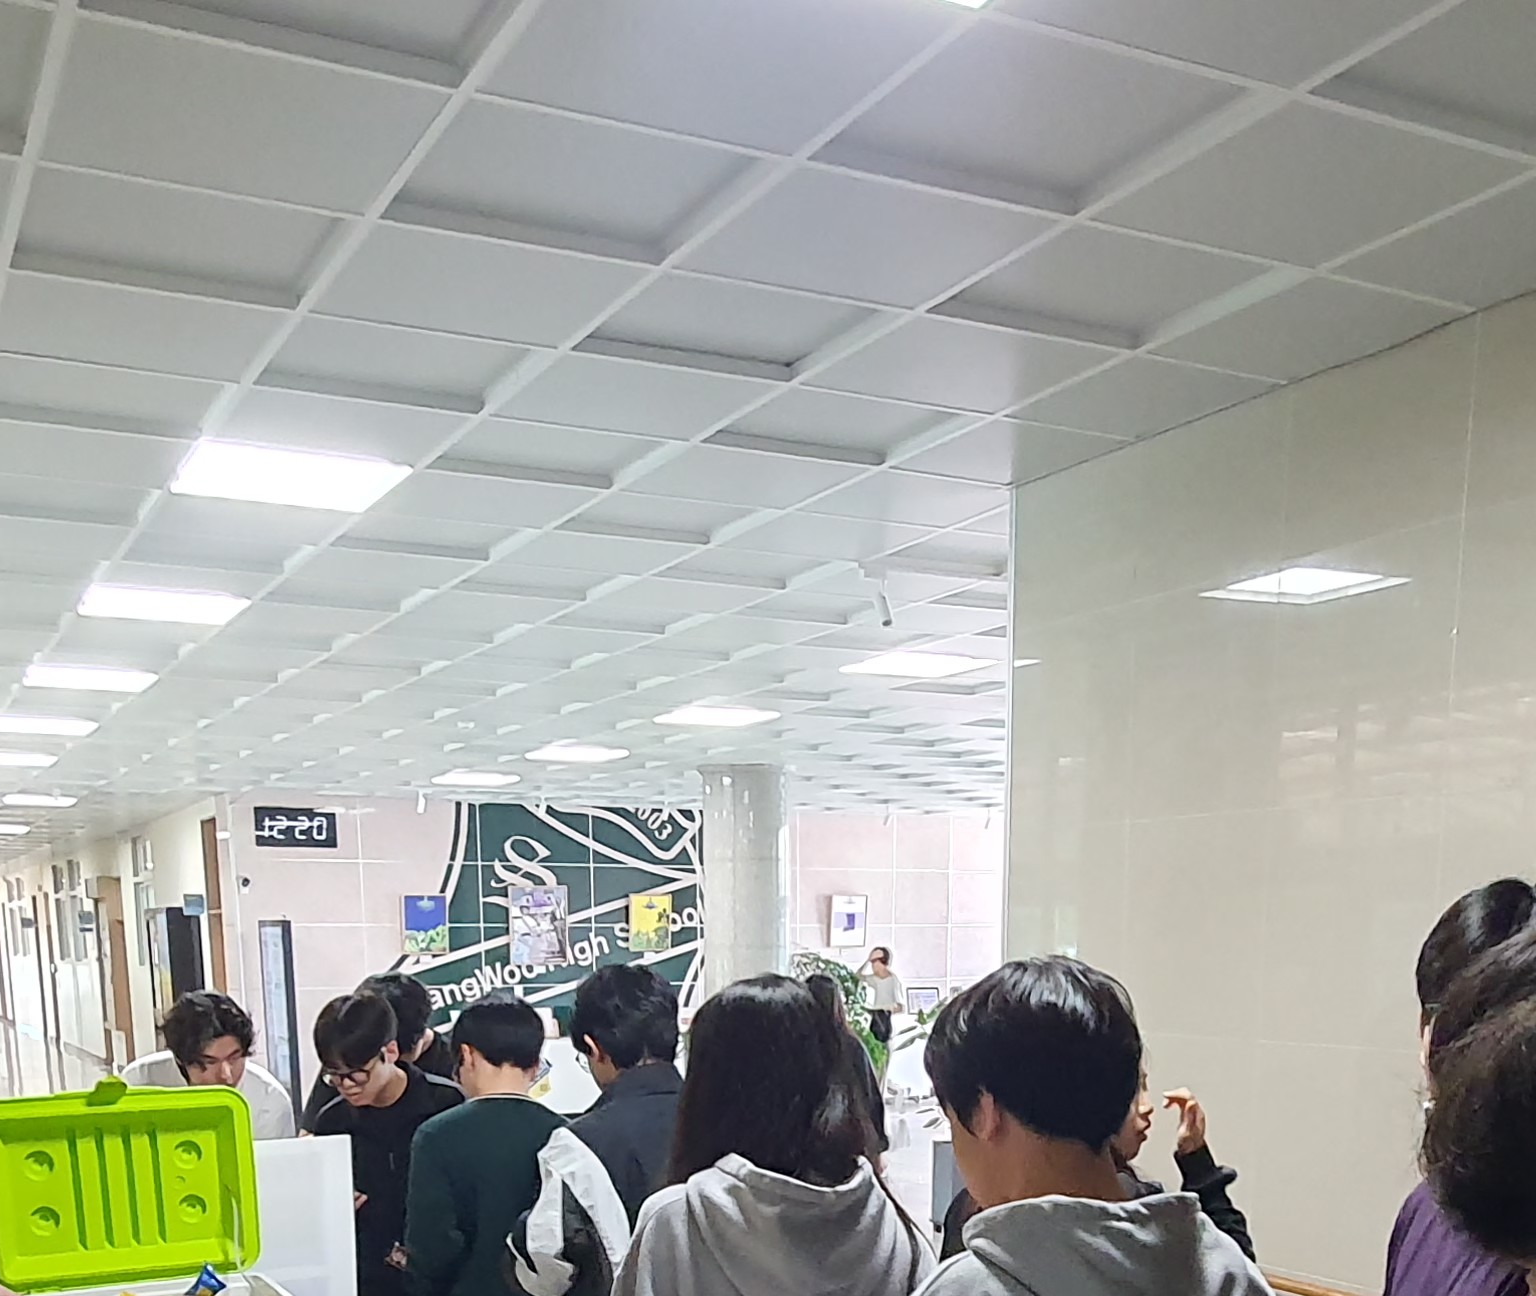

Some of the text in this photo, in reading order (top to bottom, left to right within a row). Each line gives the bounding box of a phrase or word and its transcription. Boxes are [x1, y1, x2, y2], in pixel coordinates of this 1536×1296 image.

[636, 807, 673, 841] 003
[428, 961, 538, 1011] angWoo
[613, 906, 704, 949] Soo
